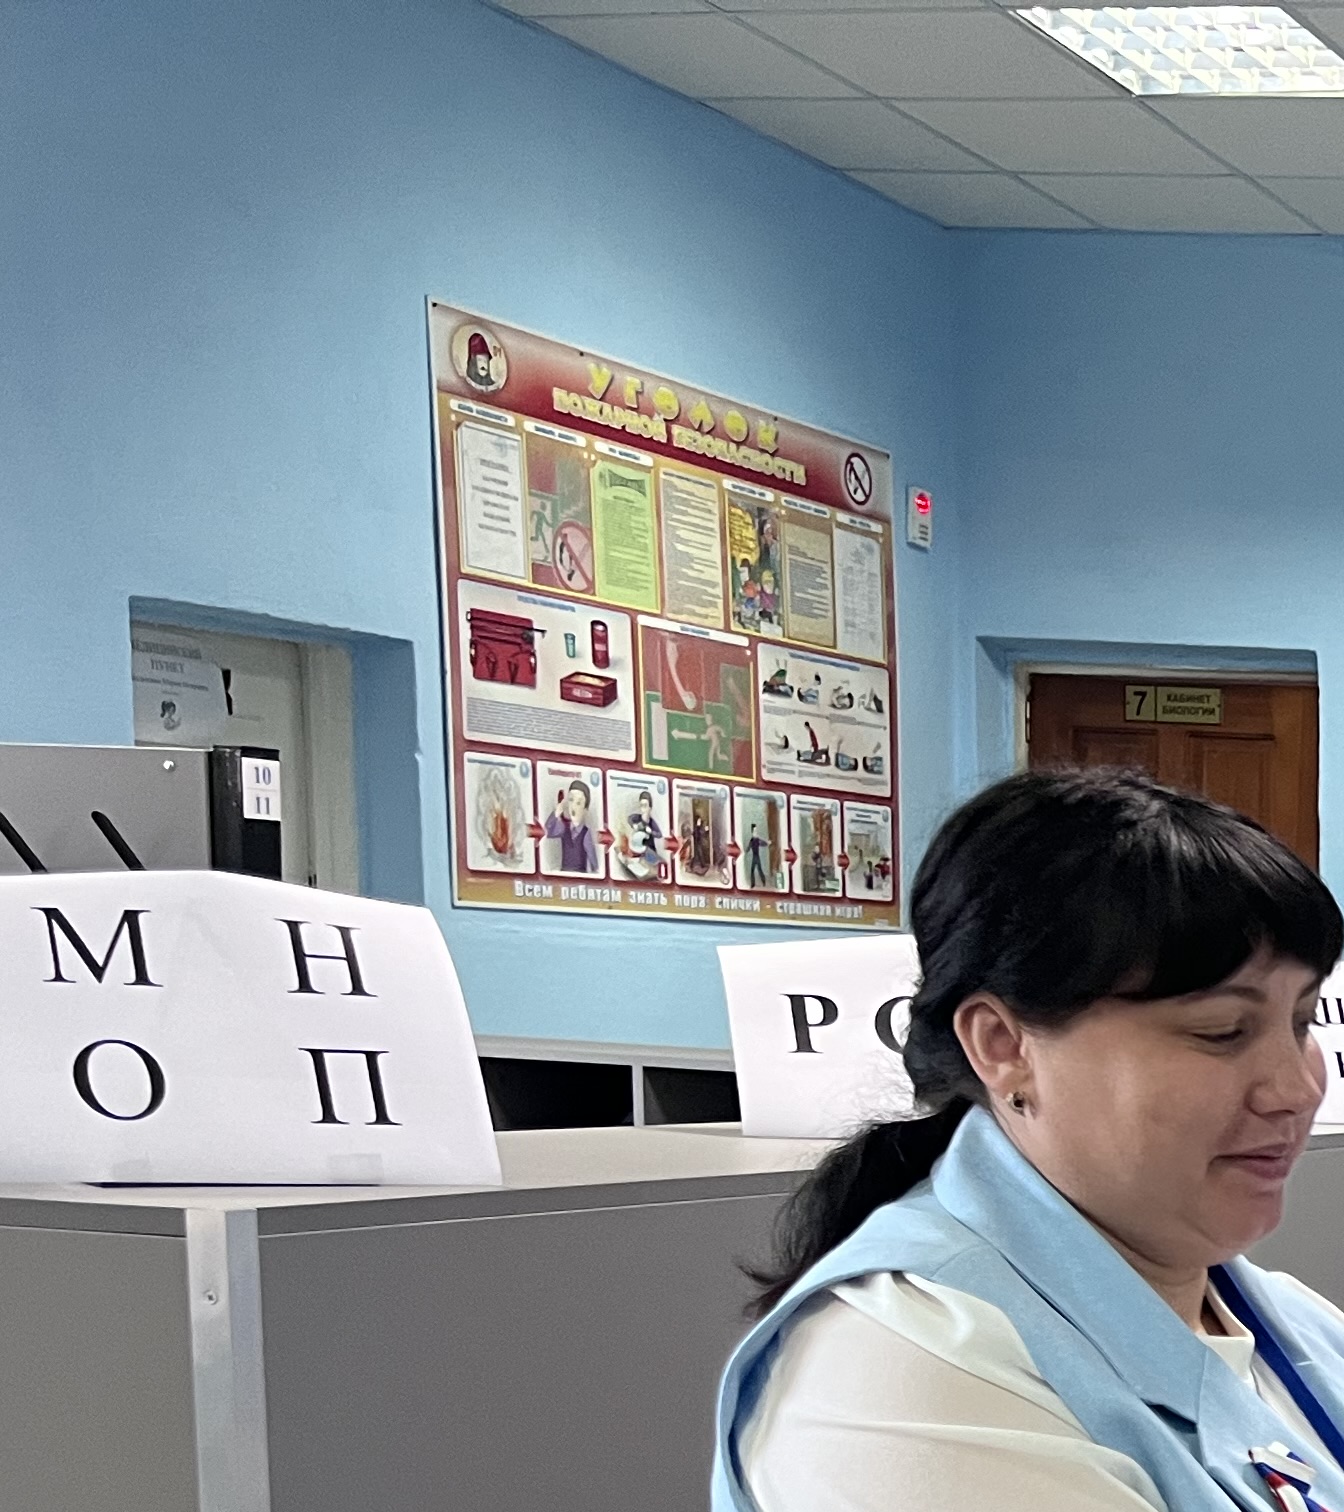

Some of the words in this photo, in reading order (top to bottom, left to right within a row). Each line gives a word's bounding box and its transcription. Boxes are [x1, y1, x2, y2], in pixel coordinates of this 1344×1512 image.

[552, 387, 668, 443] ПОЖАРНОЙ
[671, 423, 807, 488] БЕЗОПАСНОСТИ
[586, 361, 780, 455] УГОЛОК
[1132, 690, 1148, 717] 7
[1166, 692, 1212, 706] КАБИНЕТ
[253, 765, 272, 787] 10
[254, 795, 271, 816] 11
[513, 880, 553, 900] Всем
[560, 885, 623, 904] ребятам
[628, 891, 668, 907] знать
[714, 895, 761, 912] спички
[31, 905, 164, 988] М
[279, 918, 378, 997] Н
[779, 993, 839, 1054] Р
[73, 1038, 165, 1121] О
[298, 1046, 402, 1126] П
